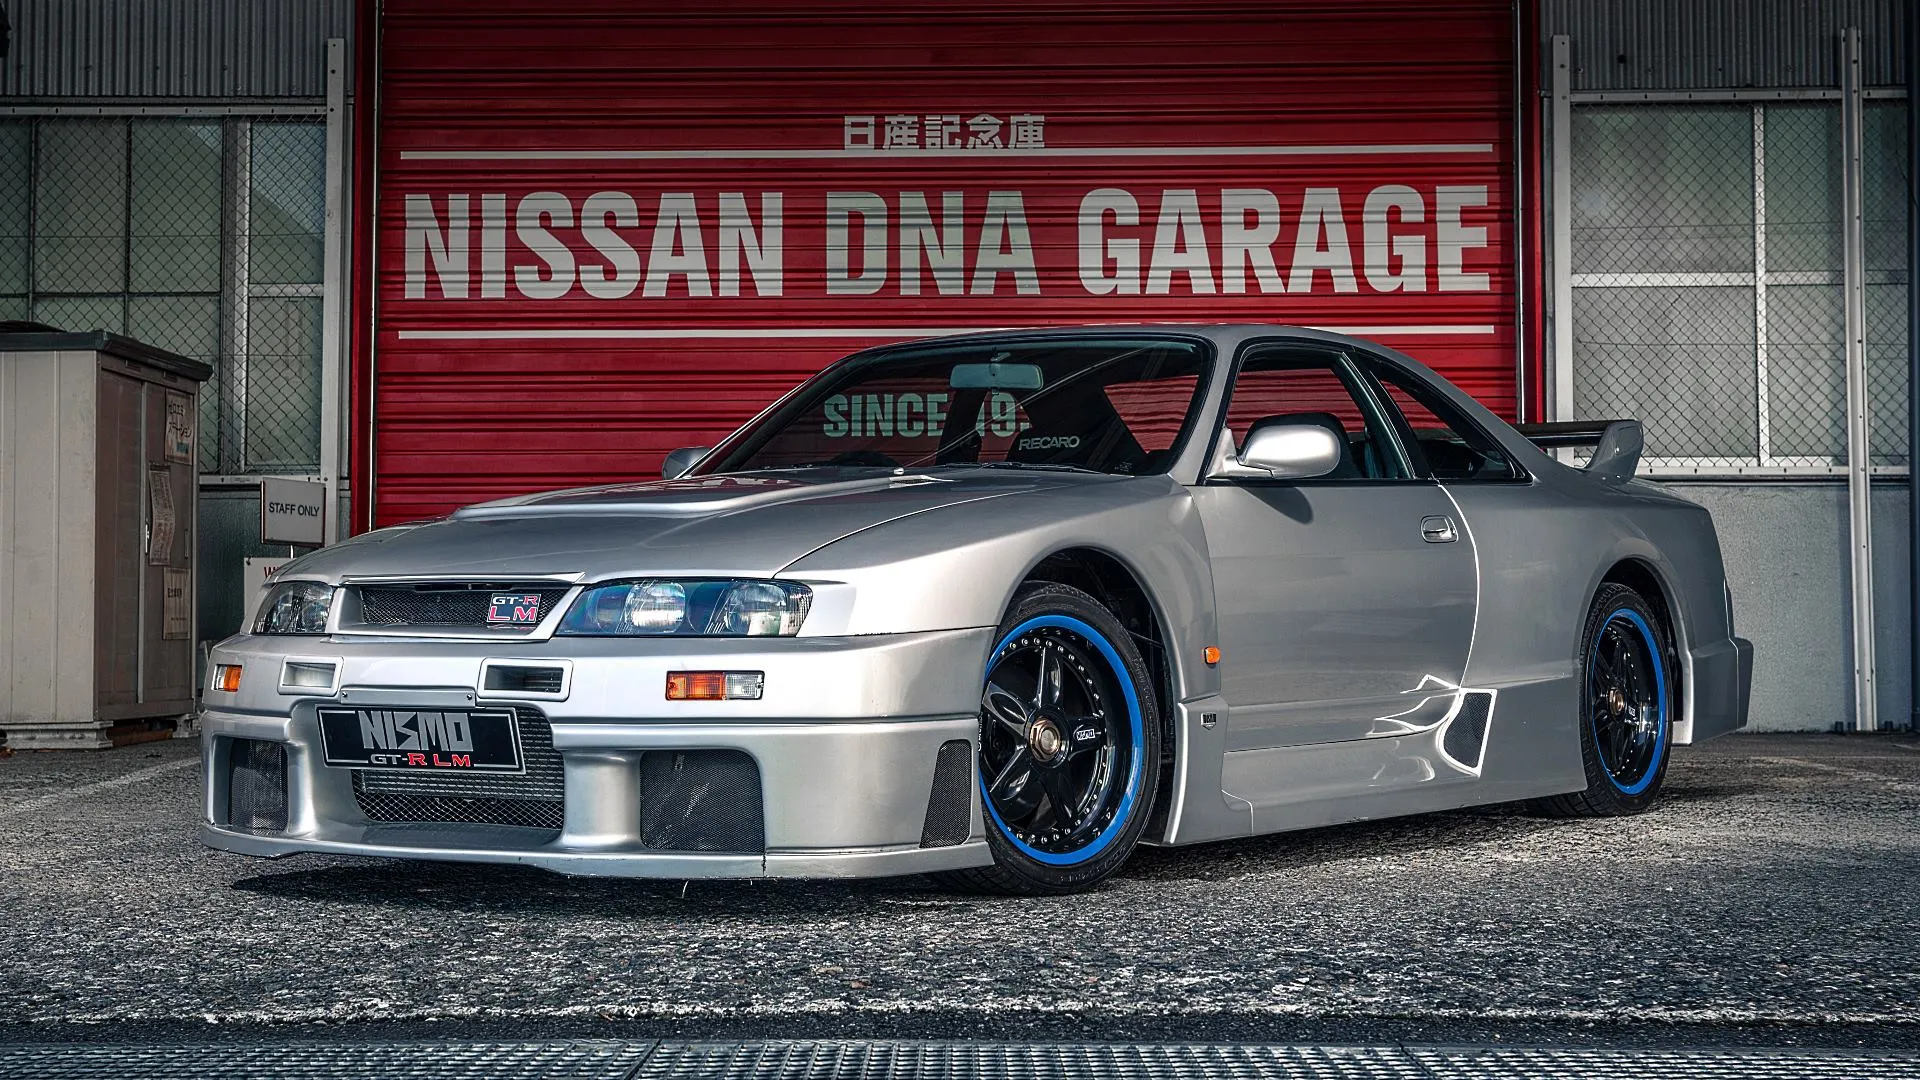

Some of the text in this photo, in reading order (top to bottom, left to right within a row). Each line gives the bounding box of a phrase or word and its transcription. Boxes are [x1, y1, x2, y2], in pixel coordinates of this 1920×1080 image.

[844, 113, 1046, 150] 日産記念庫
[404, 185, 1491, 299] NISSAN DNA GARAGE
[823, 392, 948, 438] SINCE
[1018, 435, 1080, 451] RECARO
[269, 502, 320, 517] STAFF ONLY
[492, 595, 538, 605] GT-R
[357, 710, 474, 752] NISMO
[370, 752, 471, 768] GT-R LM
